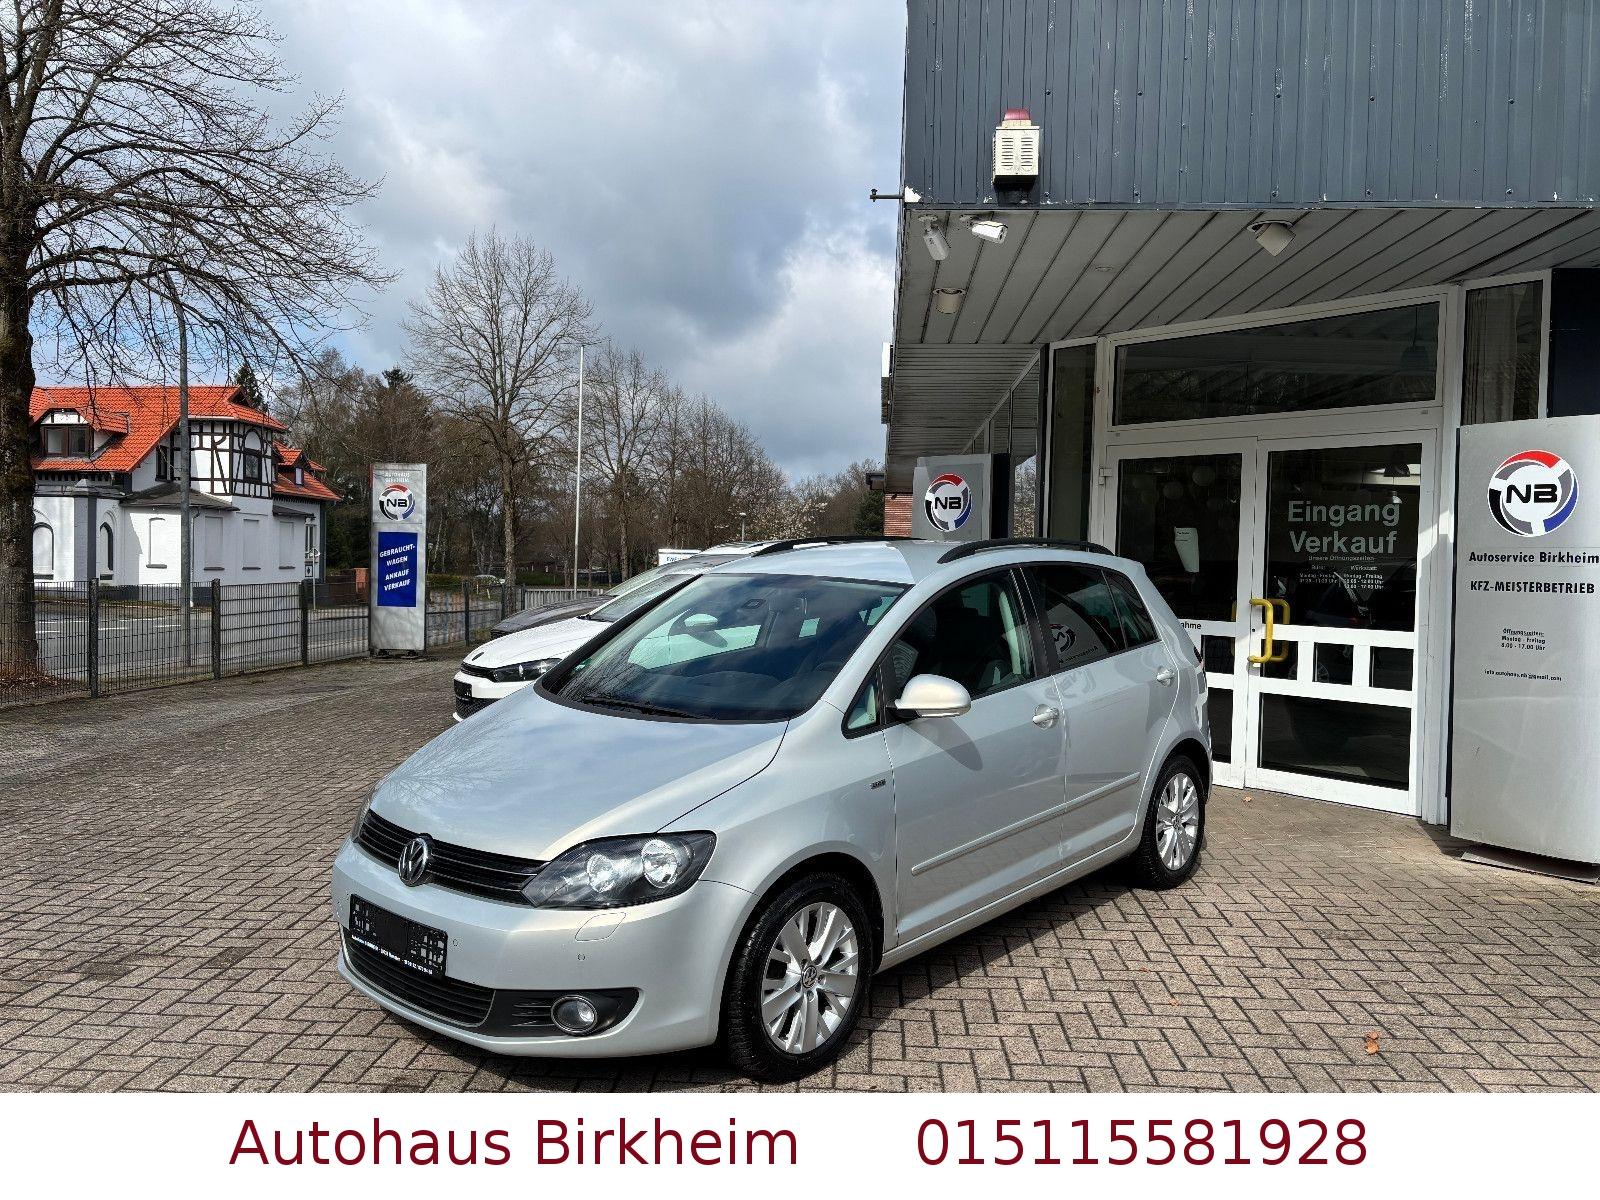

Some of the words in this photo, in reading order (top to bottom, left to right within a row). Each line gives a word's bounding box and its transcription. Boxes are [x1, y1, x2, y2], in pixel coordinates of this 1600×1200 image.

[1506, 483, 1558, 504] NB
[386, 498, 408, 508] NB
[934, 496, 962, 510] NB
[1288, 500, 1400, 527] Eingang
[1289, 530, 1398, 554] Verkauf
[379, 544, 416, 558] GEBRAUCHT-
[1468, 551, 1535, 563] Autoservice
[1539, 551, 1600, 564] Birkheim
[386, 555, 408, 567] WAGEN
[385, 568, 410, 581] ANKAUF
[383, 578, 411, 591] VERKAUF
[1470, 580, 1595, 594] KFZ-MEISTERBETRIEB
